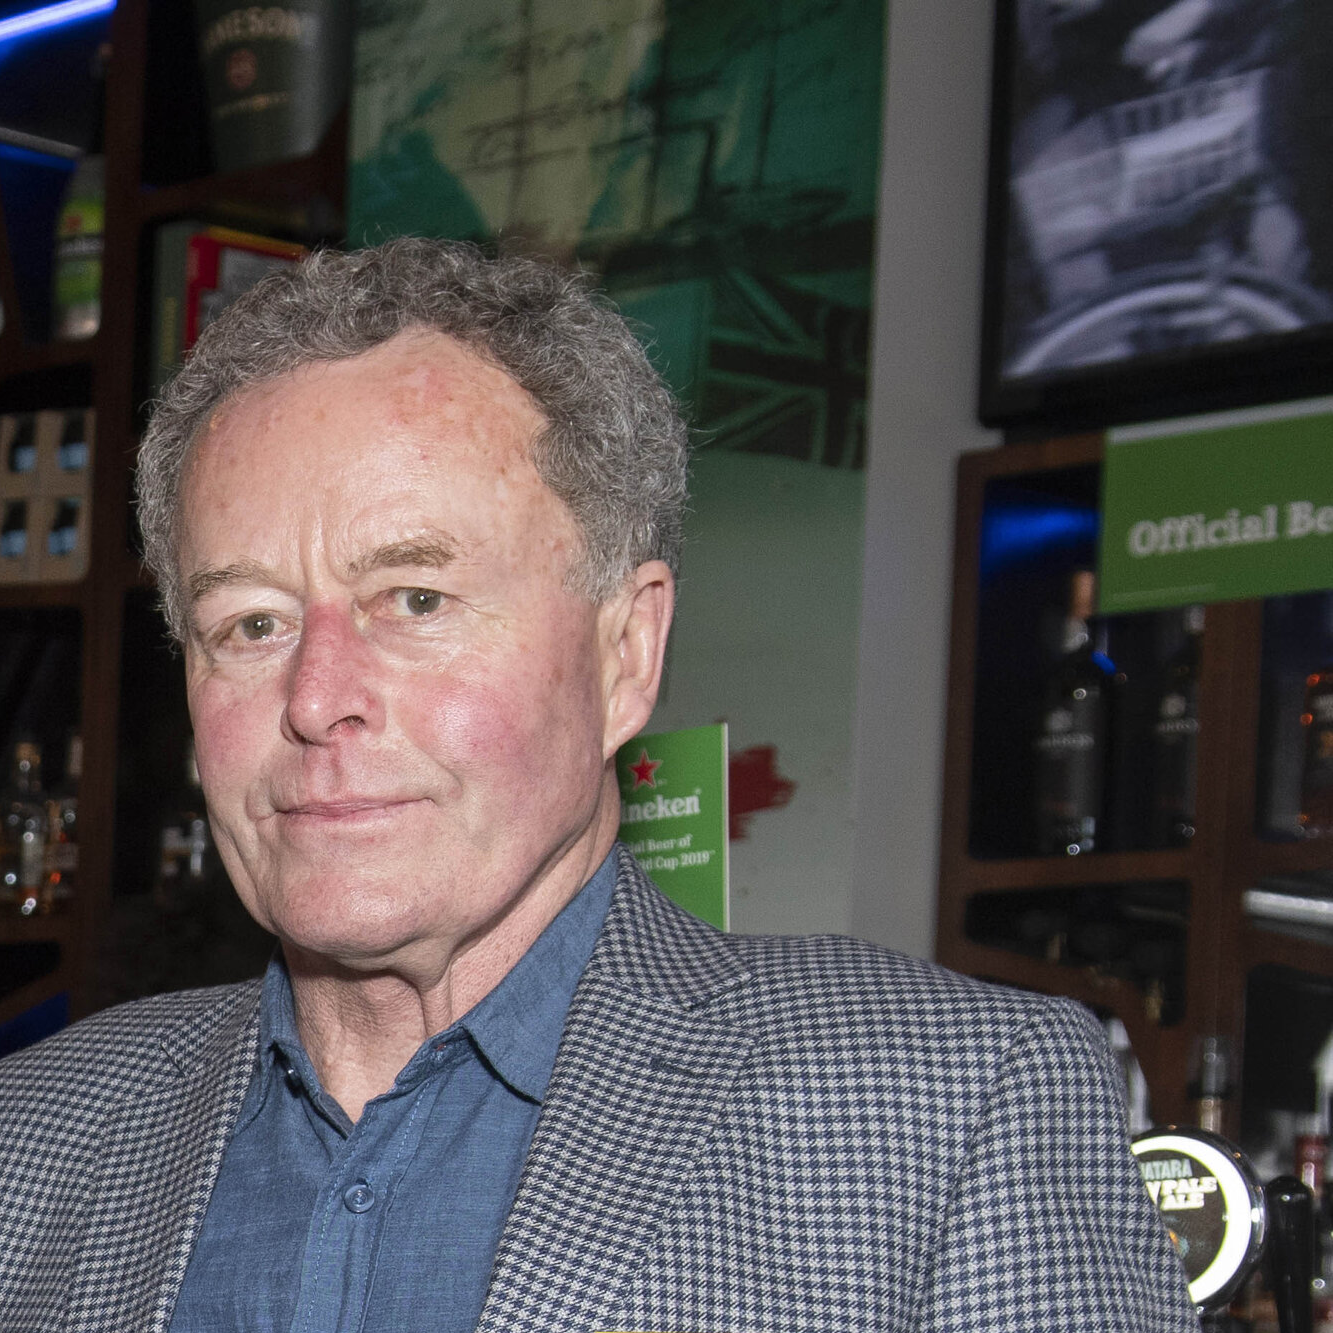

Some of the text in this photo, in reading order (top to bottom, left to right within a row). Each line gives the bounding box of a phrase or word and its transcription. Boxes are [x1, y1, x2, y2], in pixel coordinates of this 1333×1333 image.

[1129, 504, 1279, 559] Official
[647, 838, 676, 851] Beer
[677, 833, 693, 848] of
[655, 855, 679, 871] Cup
[1160, 1175, 1218, 1196] PALE
[1160, 1192, 1206, 1211] ALE
